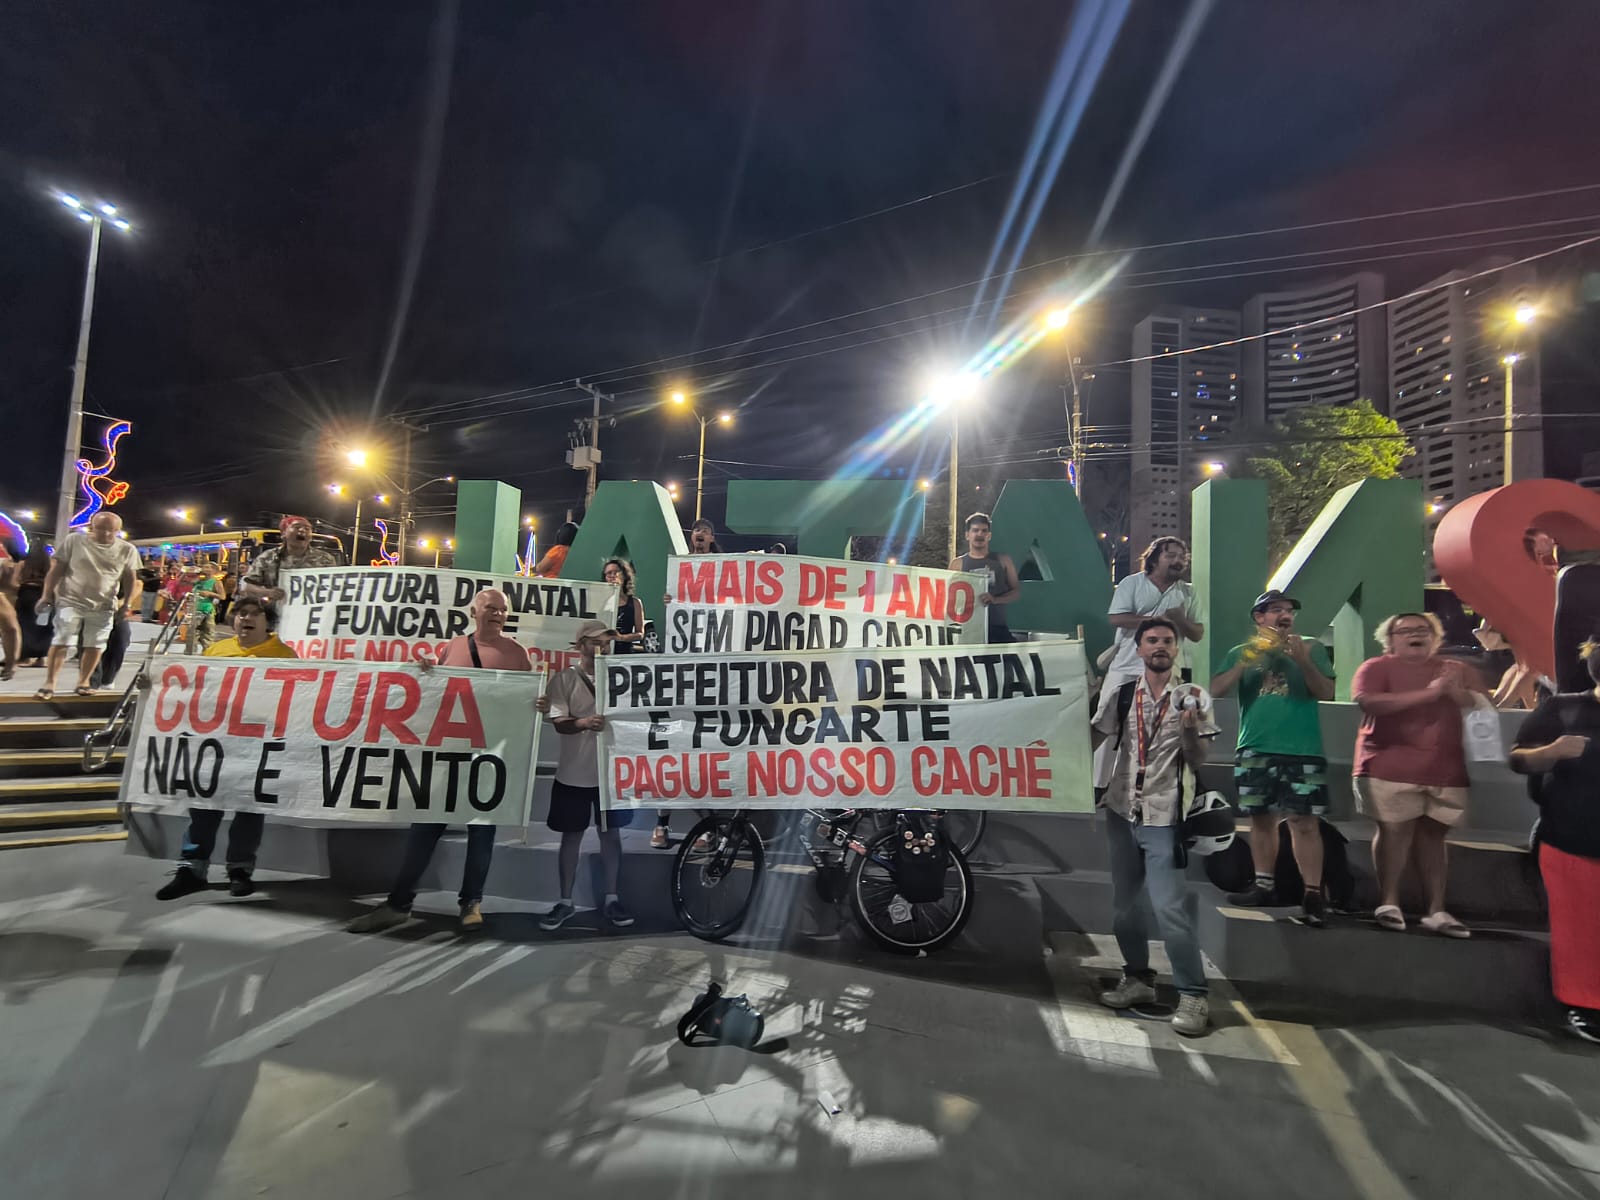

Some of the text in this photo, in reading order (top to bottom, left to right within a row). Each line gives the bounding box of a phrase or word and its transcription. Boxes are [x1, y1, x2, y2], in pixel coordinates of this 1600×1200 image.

[289, 572, 440, 605] PREFEITURA
[502, 581, 597, 619] NATAL
[677, 560, 975, 623] MAIS DE 1 ANO
[306, 606, 324, 635] E
[672, 609, 734, 654] SEM
[285, 638, 356, 660] AGUE
[608, 653, 1061, 707] PREFEITURA DE NATAL
[154, 664, 487, 749] CULTURA
[648, 704, 950, 750] E FUNCARTE
[144, 731, 224, 798] NÃO
[321, 745, 507, 812] VENTO
[615, 739, 1052, 800] PAGUE NOSSO CACHÊ
